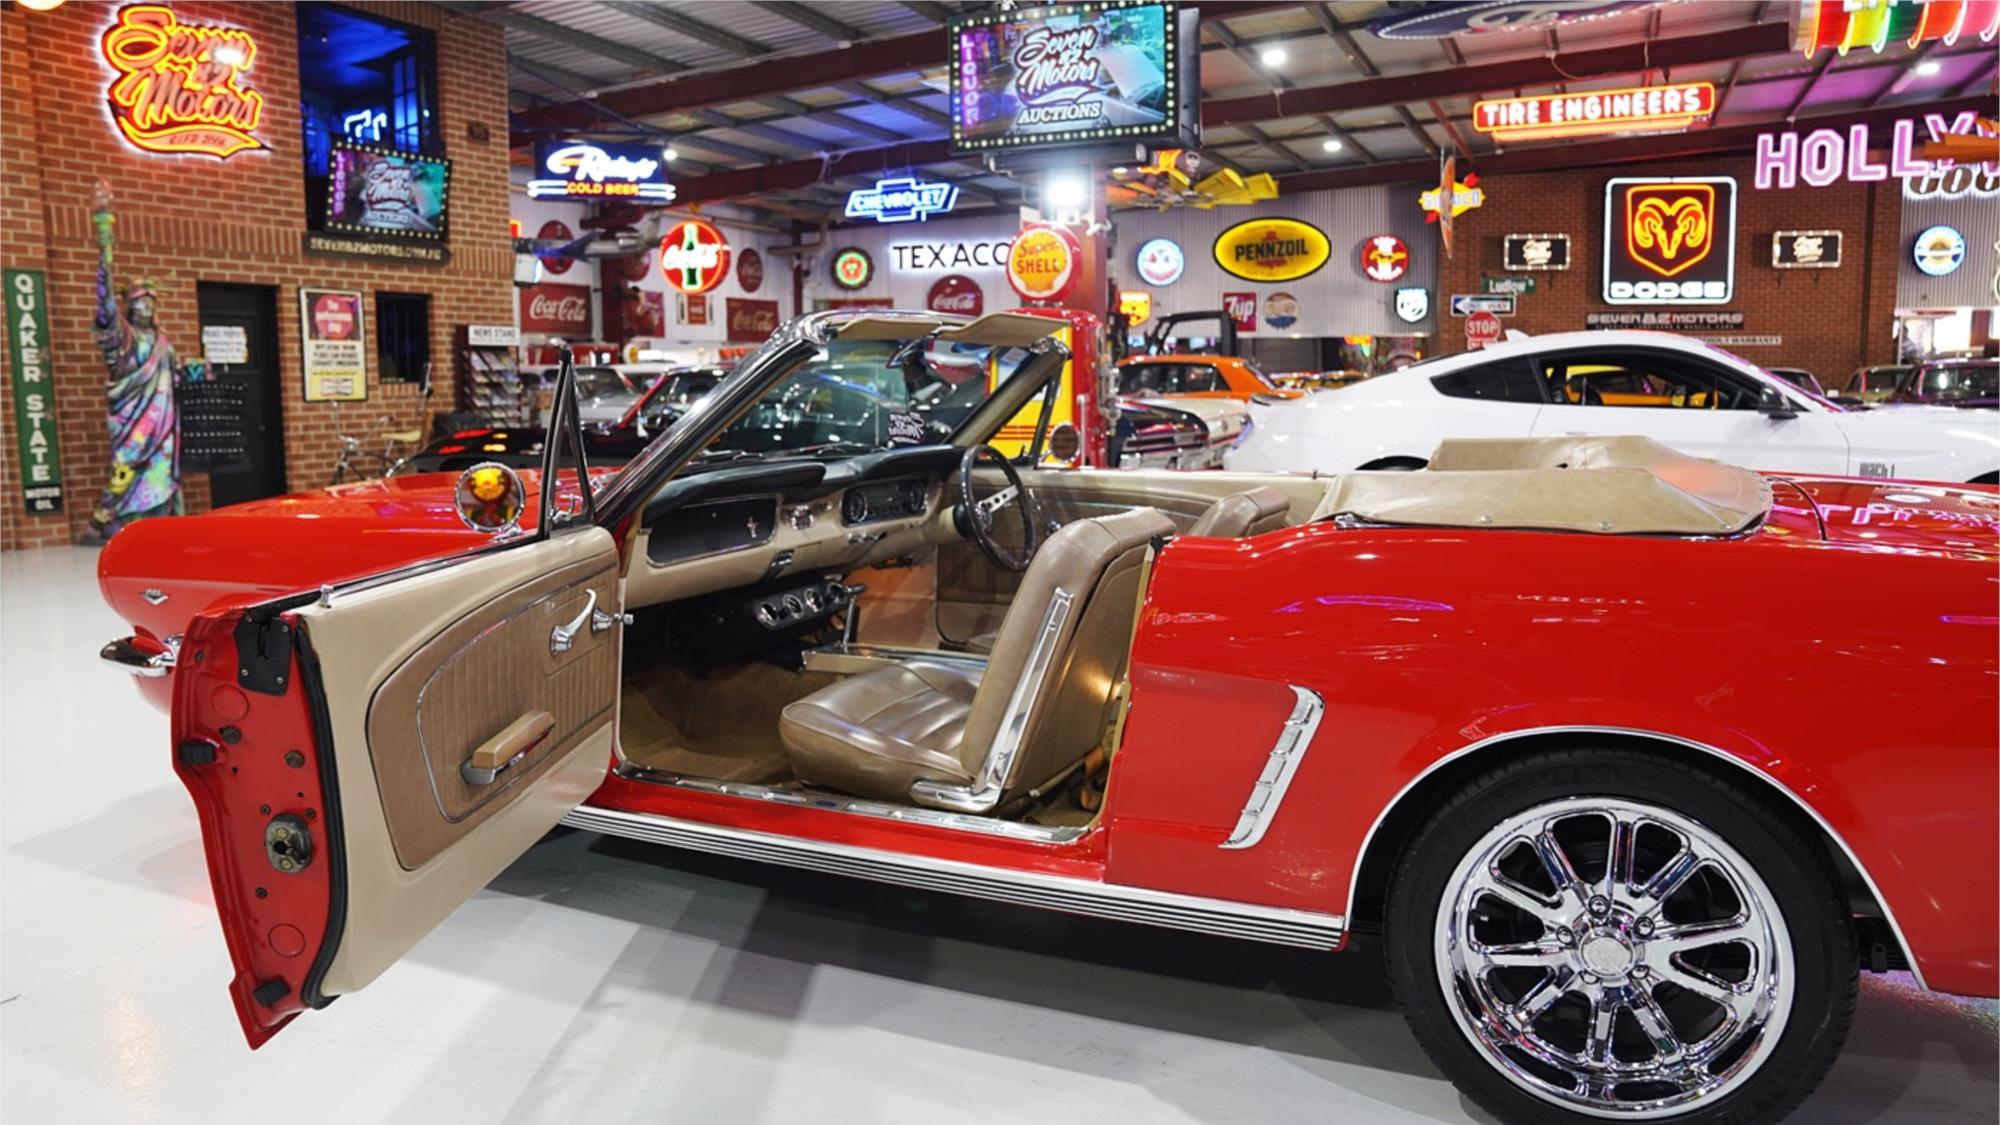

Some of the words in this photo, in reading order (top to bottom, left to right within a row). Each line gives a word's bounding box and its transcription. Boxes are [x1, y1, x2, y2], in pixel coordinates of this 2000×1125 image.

[105, 6, 257, 72] Seven
[1016, 28, 1095, 68] Seven
[961, 34, 979, 125] LIQUOR
[1018, 58, 1098, 95] Motors
[113, 68, 264, 129] Motors
[1482, 104, 1540, 127] TIRE
[1550, 87, 1701, 123] ENGINEERS
[1017, 102, 1101, 125] AUCTIONS
[1754, 111, 1999, 189] HOLLY
[567, 182, 602, 195] COLD
[604, 183, 640, 195] BEER
[853, 189, 943, 211] CHEVROLET
[1018, 239, 1060, 259] Super
[1235, 238, 1310, 262] PENNZOIL
[1016, 259, 1060, 274] SHELL
[1489, 279, 1526, 293] Ludlow
[1610, 281, 1726, 298] DODGE
[529, 294, 586, 322] Coca-Cola
[1463, 303, 1481, 311] ONE
[1488, 303, 1507, 311] WAY
[1672, 313, 1743, 324] MOTORS
[14, 273, 41, 383] QUAKER
[474, 328, 492, 337] NEWS
[495, 328, 516, 338] STAND
[1468, 320, 1498, 335] STOP
[26, 394, 50, 482] STATE
